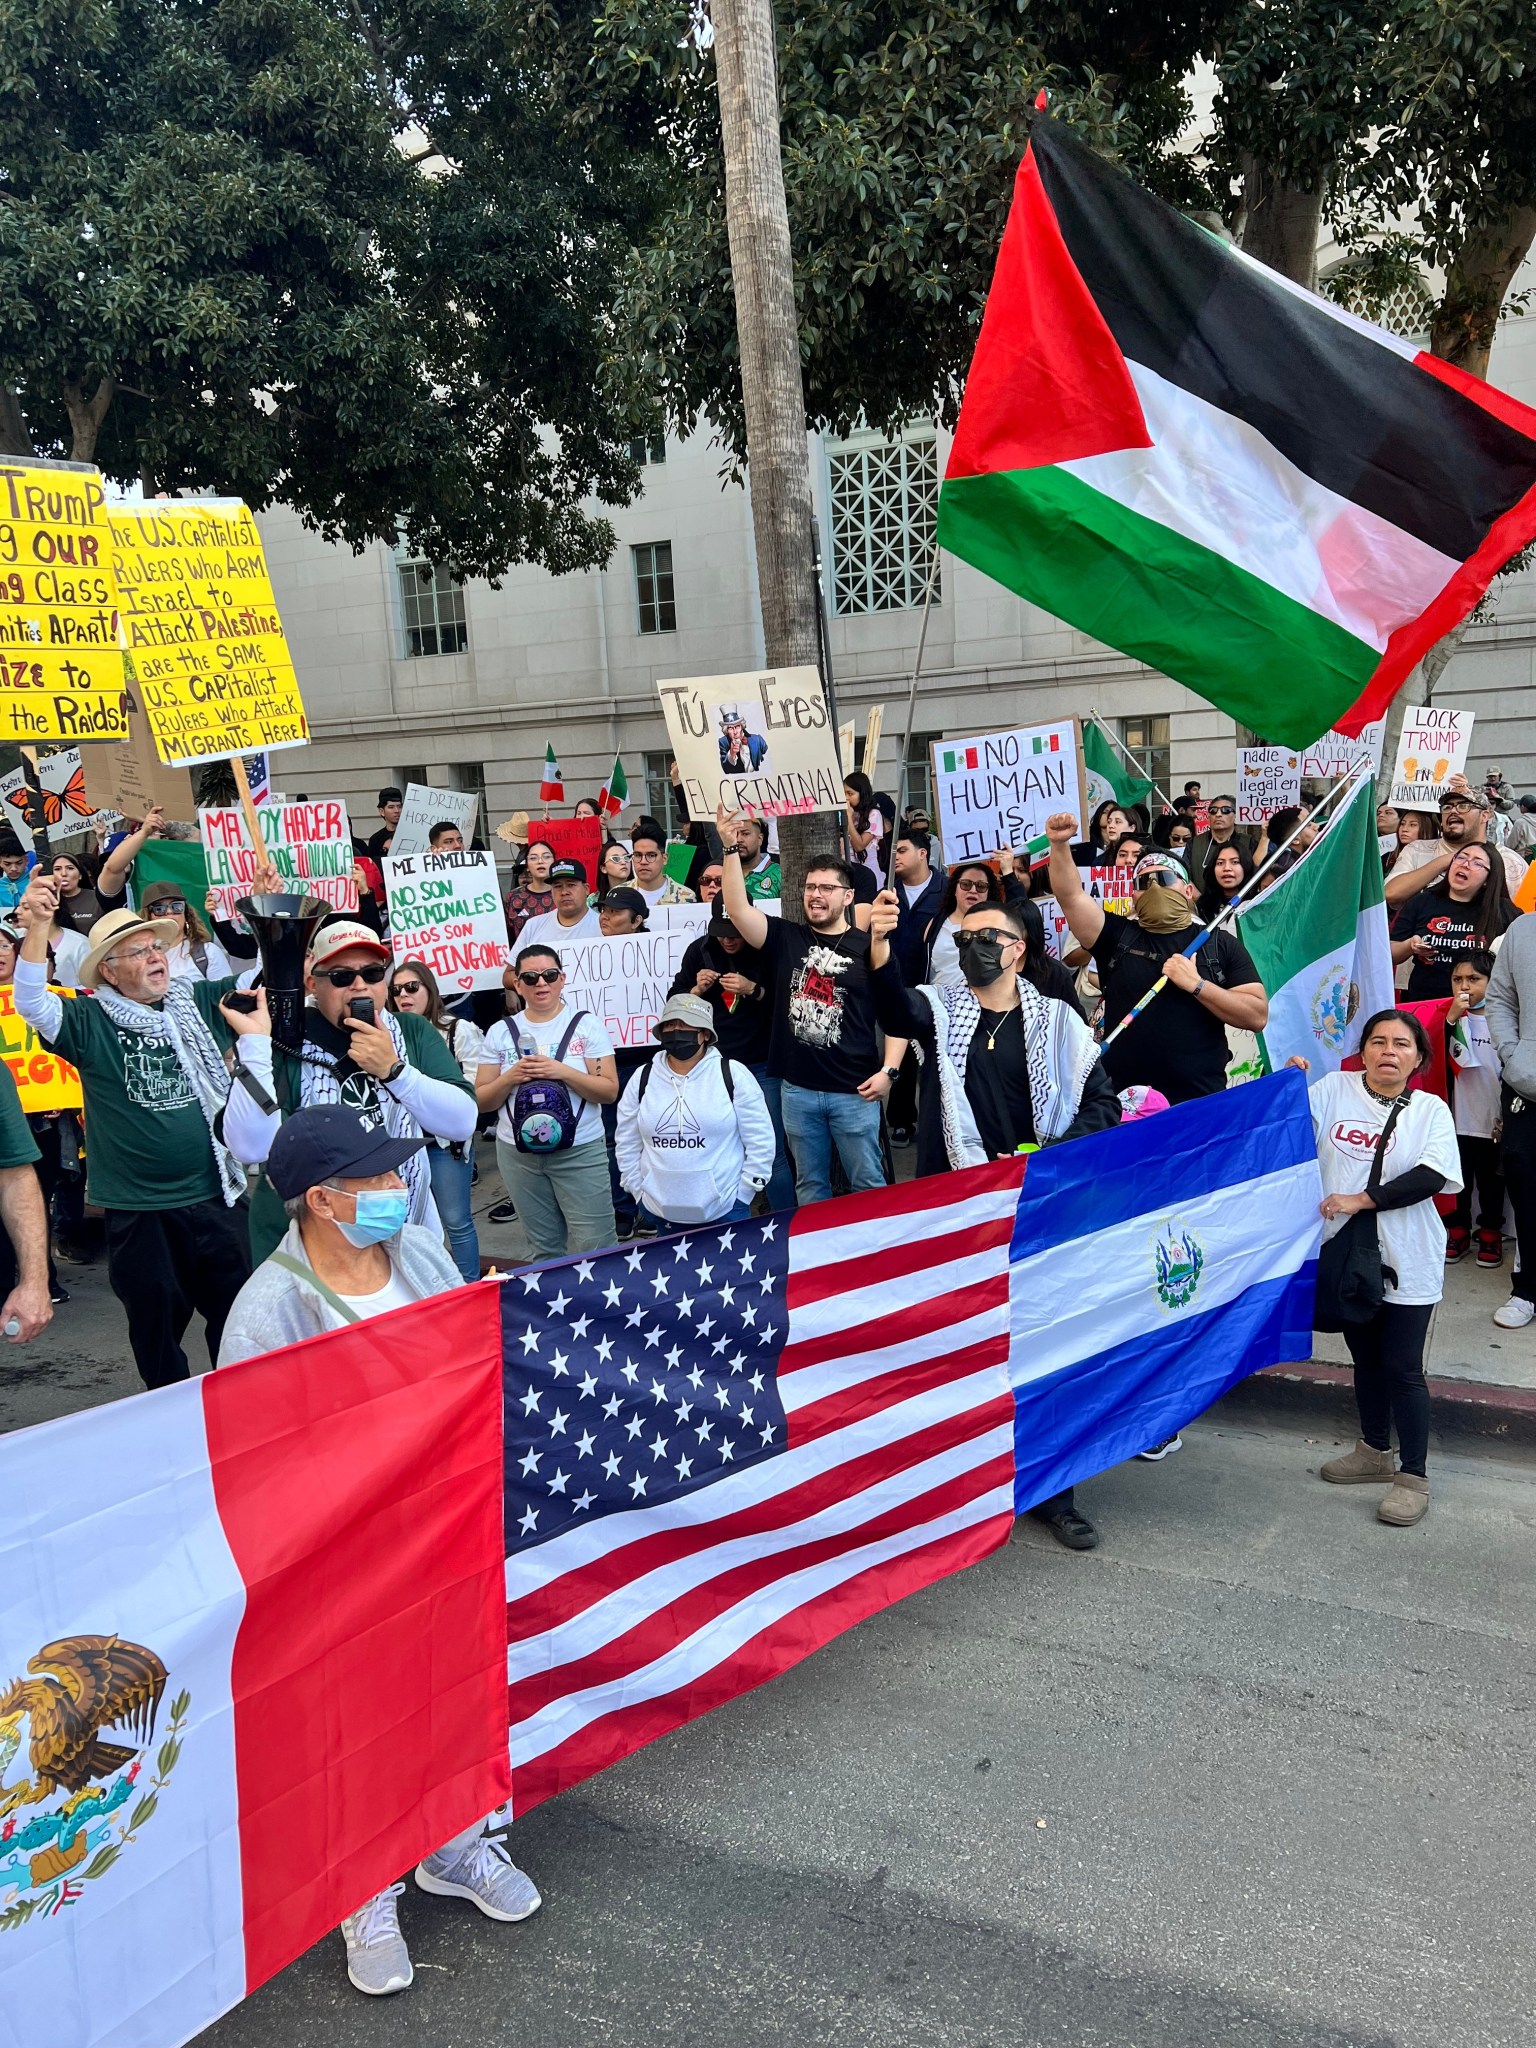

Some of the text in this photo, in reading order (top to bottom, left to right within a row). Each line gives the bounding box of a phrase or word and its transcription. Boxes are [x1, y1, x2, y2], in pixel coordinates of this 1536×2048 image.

[207, 582, 232, 606] to
[59, 660, 91, 689] to
[145, 681, 182, 707] U.S.
[9, 704, 49, 733] the
[661, 677, 827, 737] Tú Eres
[1416, 709, 1461, 729] LOCK
[985, 736, 1019, 769] NO
[1404, 731, 1460, 753] TRUMP
[1244, 748, 1279, 763] nadie
[1303, 759, 1360, 777] EVIL
[1264, 765, 1285, 778] es
[686, 768, 847, 815] EL CRIMINAL
[951, 760, 1065, 814] HUMAN
[1240, 778, 1298, 796] ilegal en
[1391, 784, 1452, 801] GUANTANAM
[407, 789, 470, 811] I DRINK
[739, 796, 817, 819] TRUMP
[283, 803, 342, 842] HACER
[999, 806, 1024, 829] IS
[206, 849, 232, 885] LA
[308, 842, 353, 878] NUNCA
[393, 851, 487, 876] MI FAMILIA
[391, 880, 453, 909] NO SON
[390, 892, 497, 932] CRIMINALES
[393, 927, 440, 951] ELLOS
[444, 923, 473, 940] SON
[1435, 921, 1474, 932] Chula
[558, 935, 681, 985] EXICO ONCE
[626, 982, 670, 1015] LAN
[652, 1131, 706, 1149] Reebok
